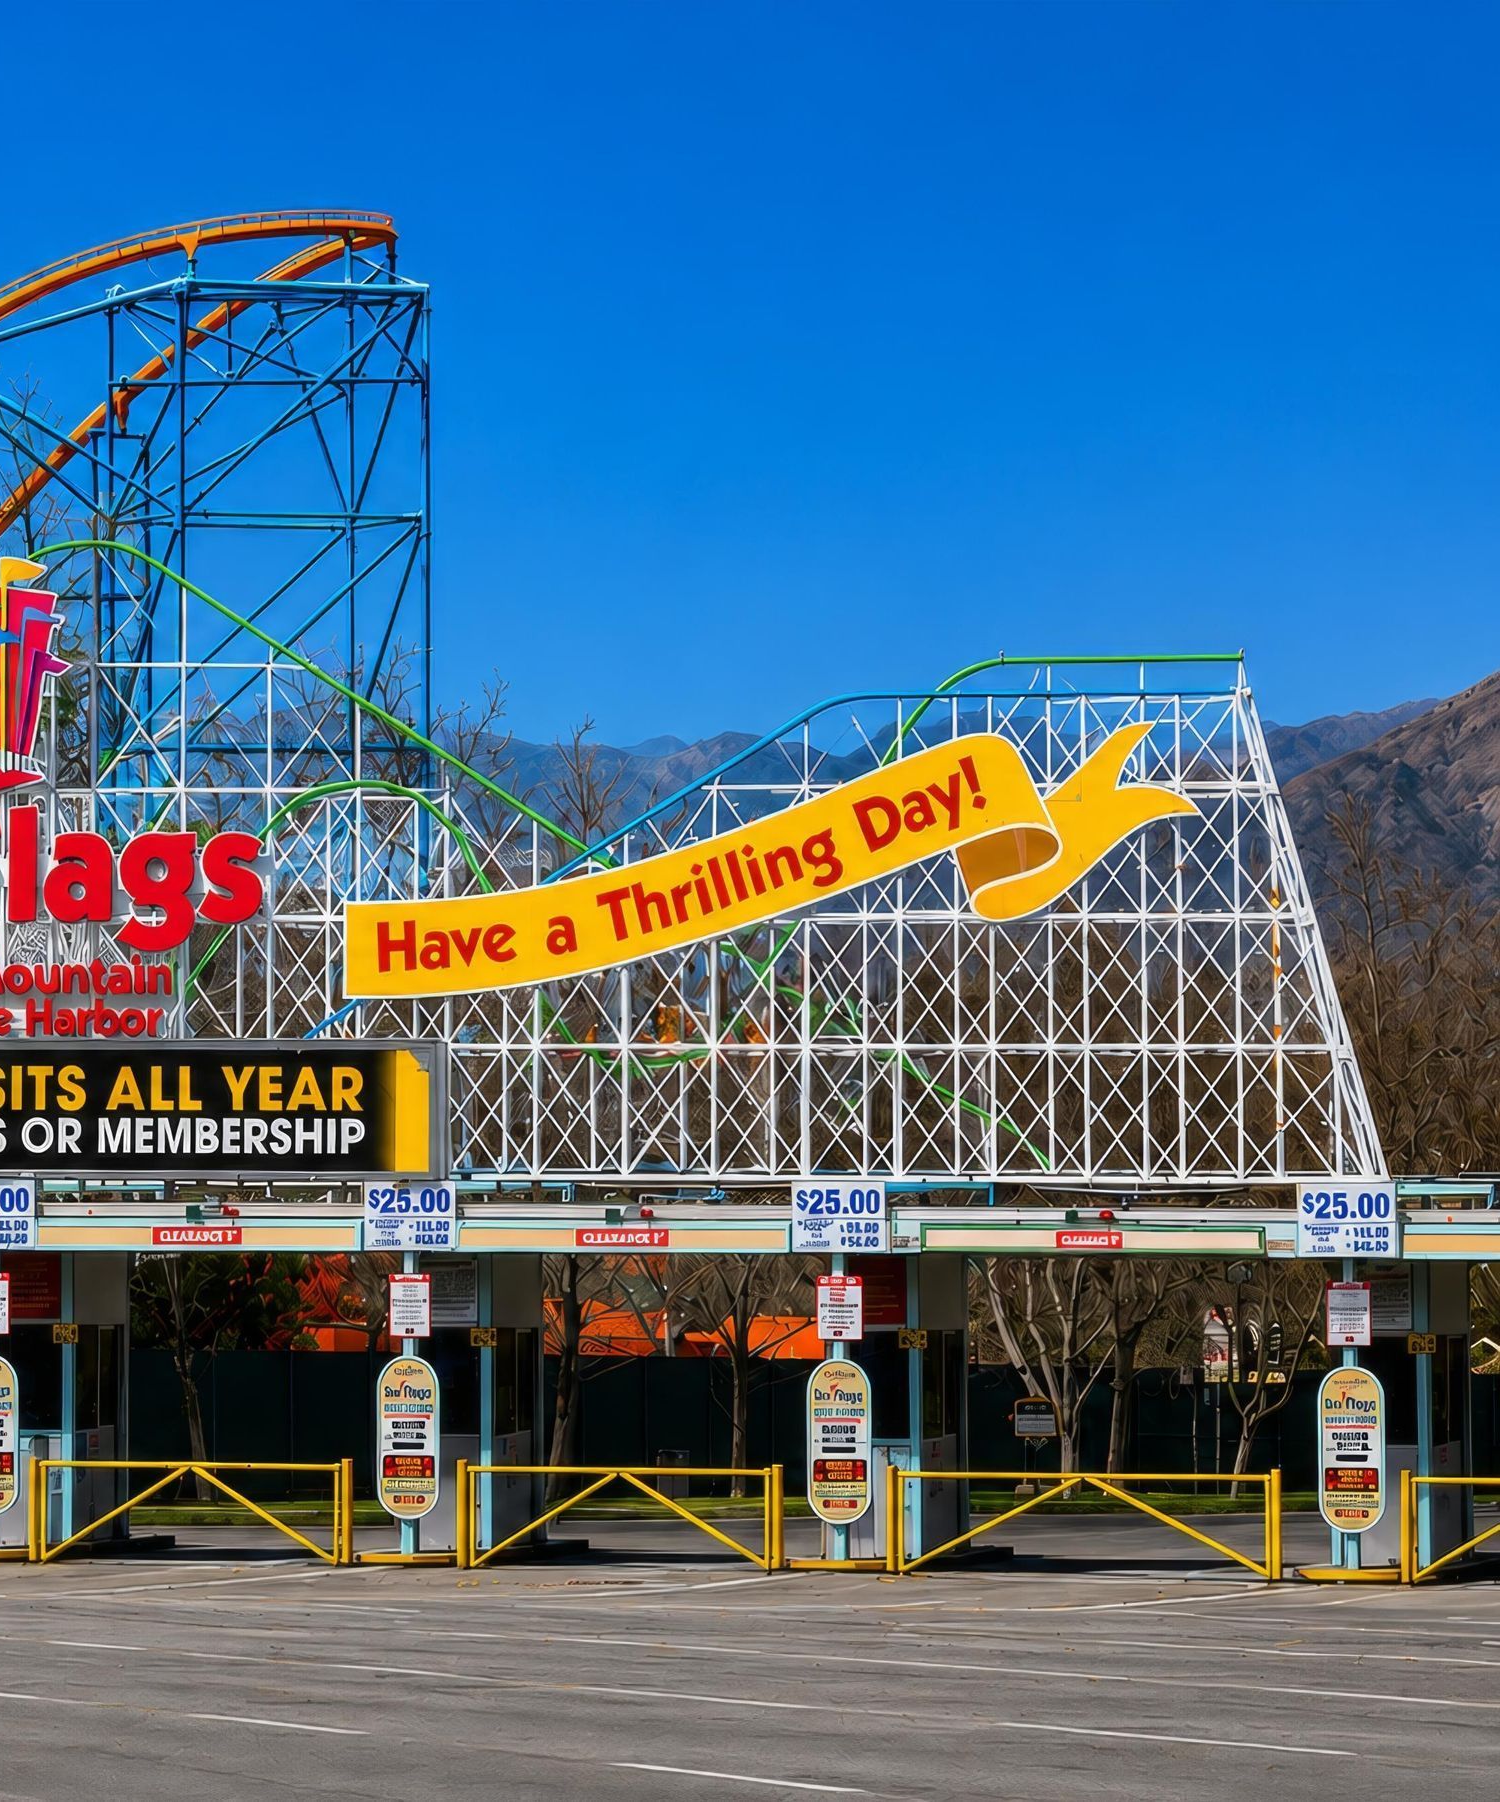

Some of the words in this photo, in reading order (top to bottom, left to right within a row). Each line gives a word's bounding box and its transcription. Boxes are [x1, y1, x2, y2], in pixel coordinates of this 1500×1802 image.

[377, 920, 517, 973] Have
[546, 916, 578, 955] a
[596, 829, 843, 941] Thrilling
[852, 756, 987, 853] Day!
[25, 997, 164, 1038] Harbor
[106, 1066, 202, 1111] ALL
[222, 1066, 363, 1111] YEAR
[21, 1117, 82, 1154] OR
[97, 1117, 366, 1155] MEMBERSHIP
[368, 1188, 451, 1213] $25.00
[796, 1189, 880, 1215] $25.00
[1302, 1192, 1390, 1220] $25.00
